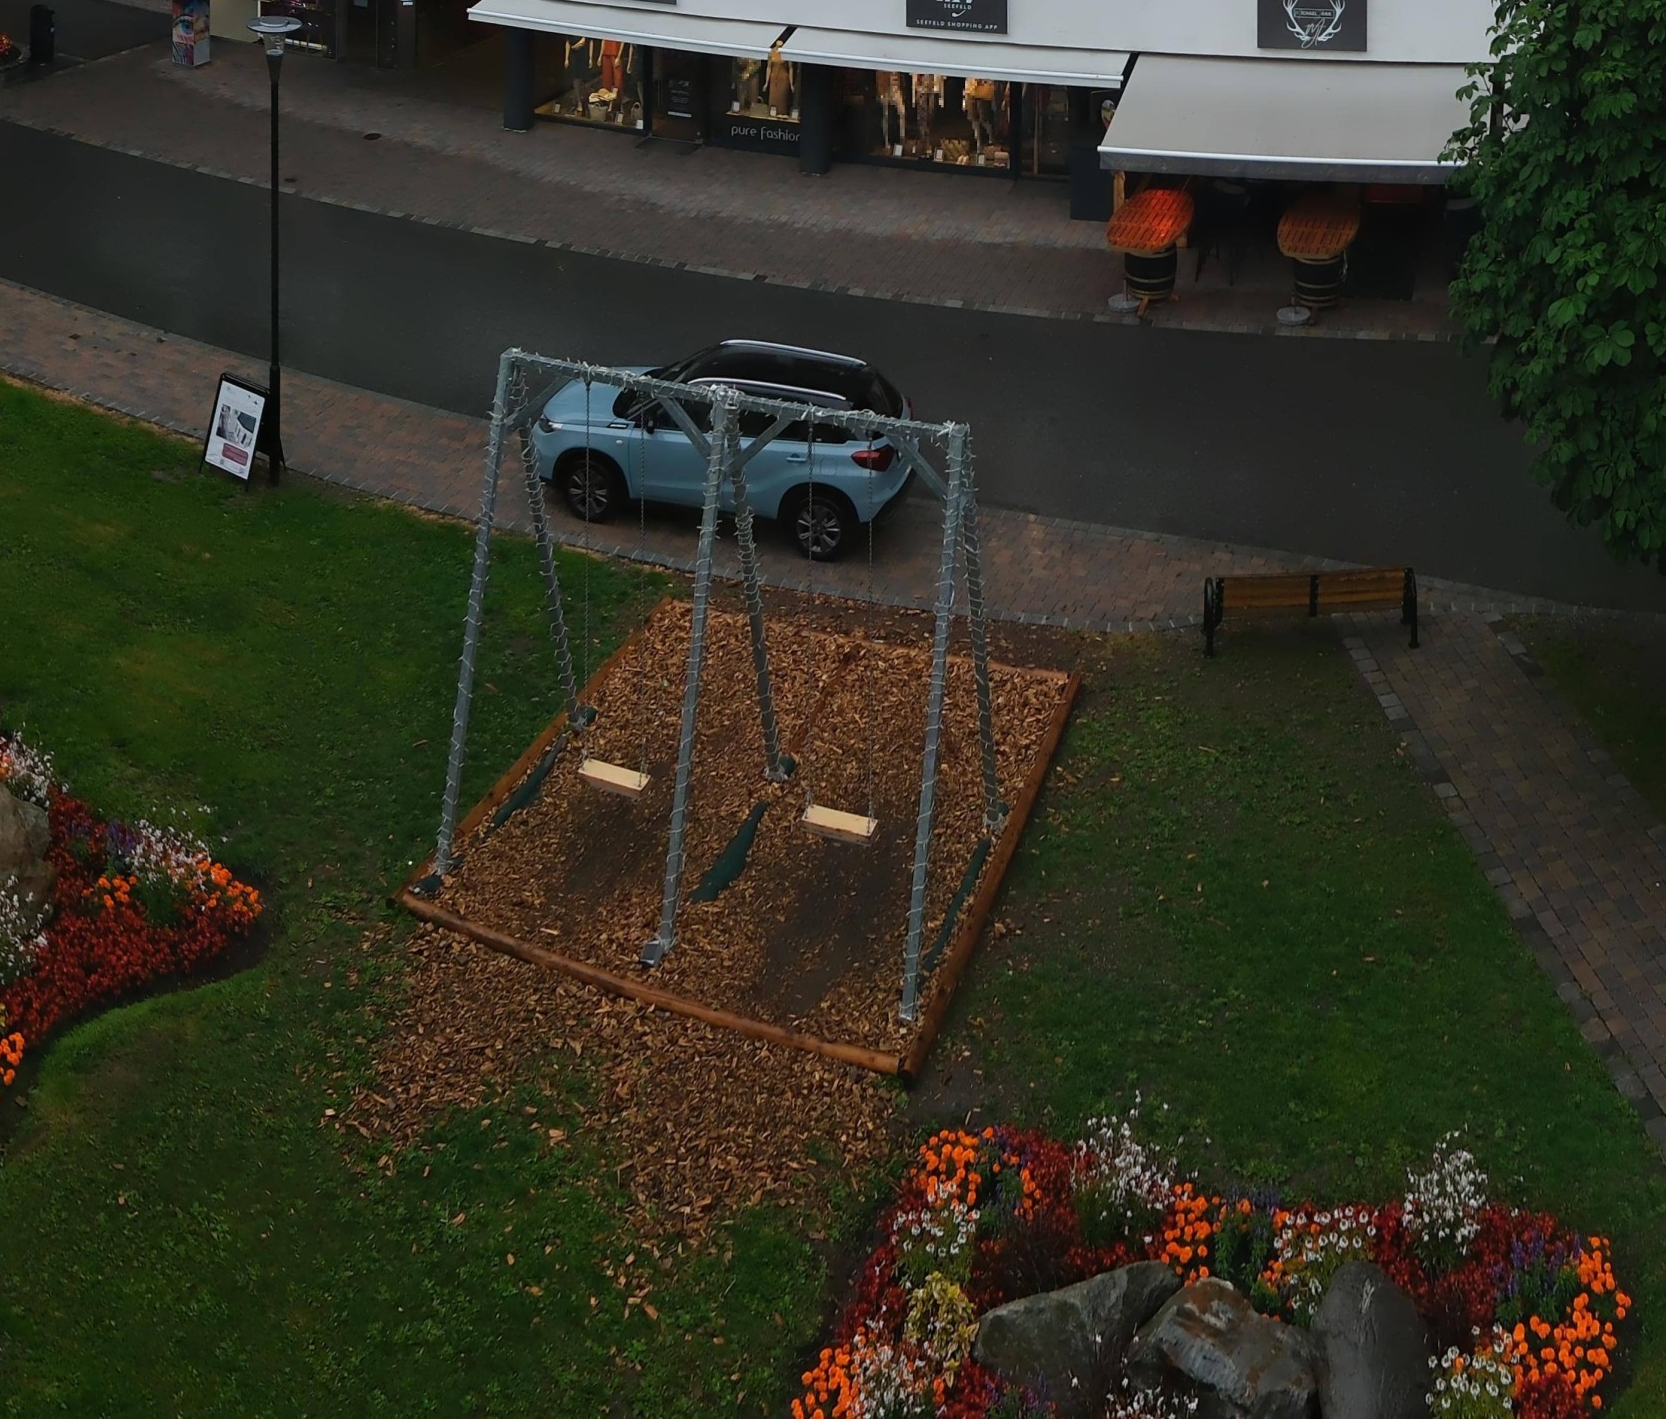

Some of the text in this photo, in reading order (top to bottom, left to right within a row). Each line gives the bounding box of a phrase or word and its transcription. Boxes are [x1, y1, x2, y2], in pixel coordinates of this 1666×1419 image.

[916, 19, 945, 27] SEEFELD
[947, 21, 982, 29] SHOPPING
[731, 125, 757, 139] pure
